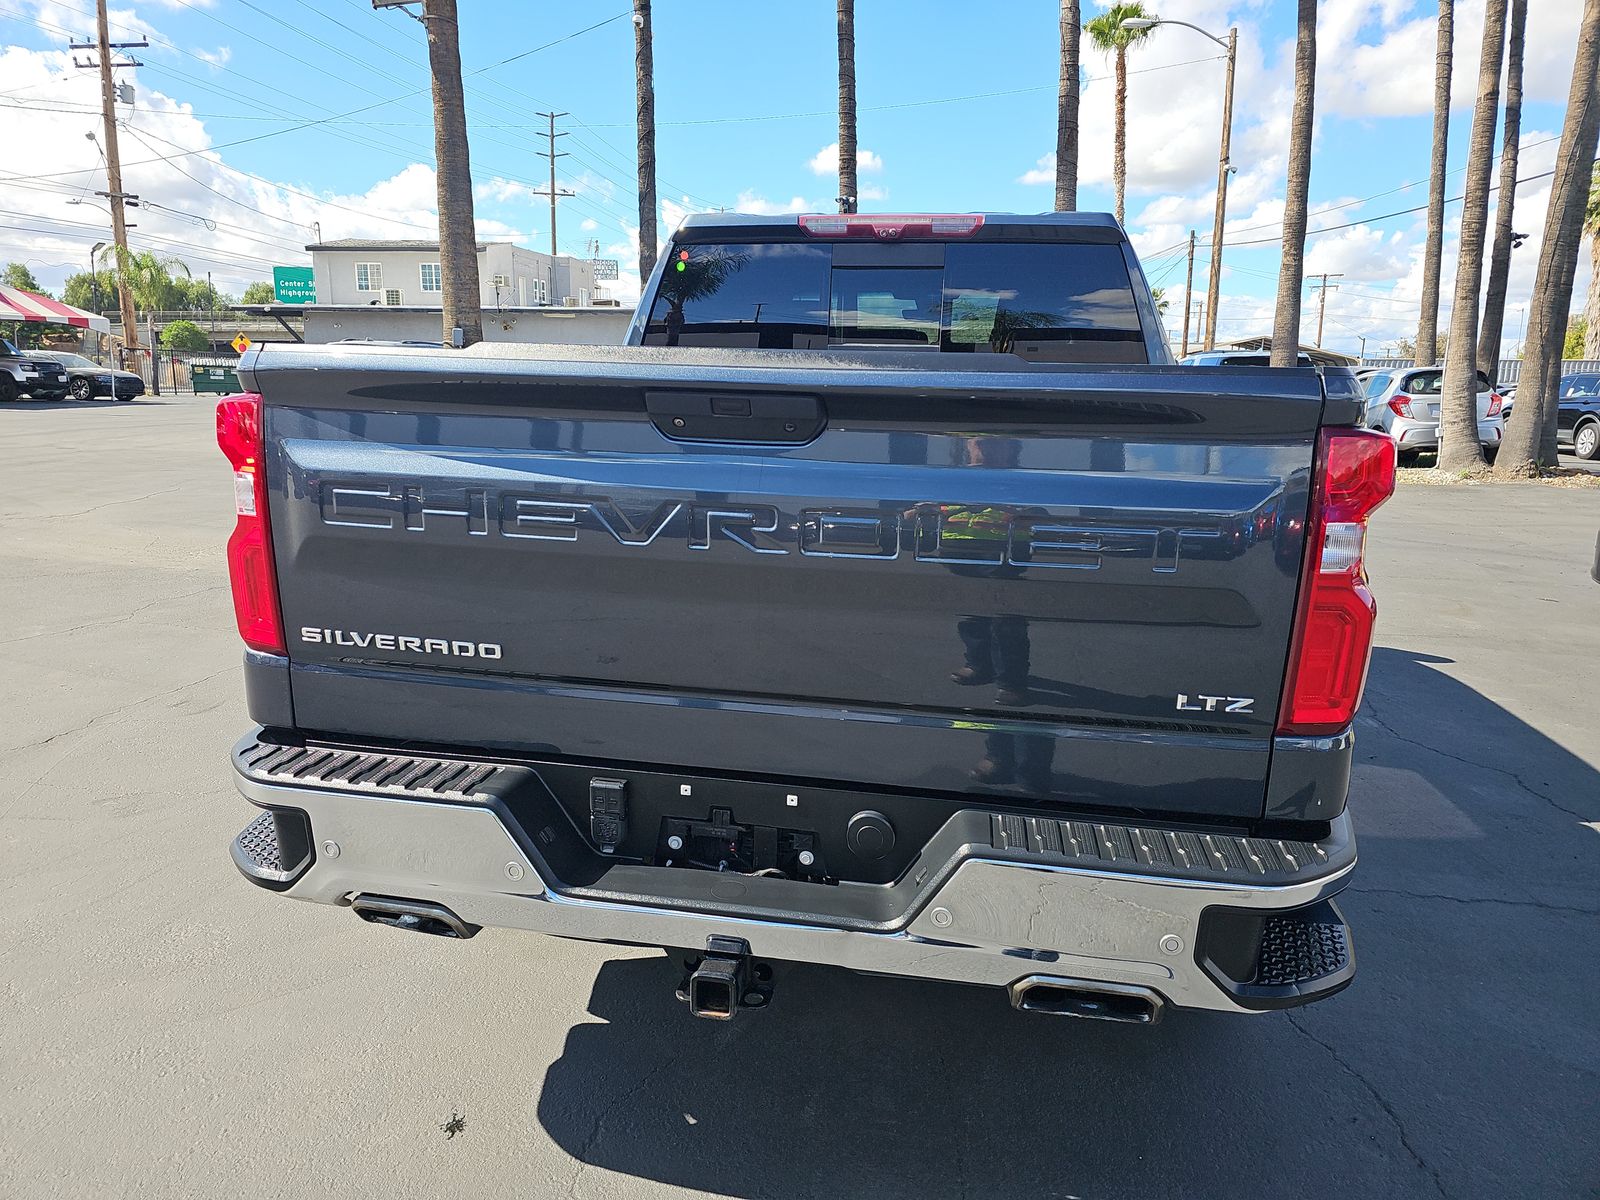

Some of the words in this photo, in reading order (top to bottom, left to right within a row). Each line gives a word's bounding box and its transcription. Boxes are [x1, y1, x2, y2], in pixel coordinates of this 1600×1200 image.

[319, 479, 1222, 574] CHEVROLET
[301, 627, 502, 660] SILVERADO
[1176, 693, 1255, 713] LTZ
